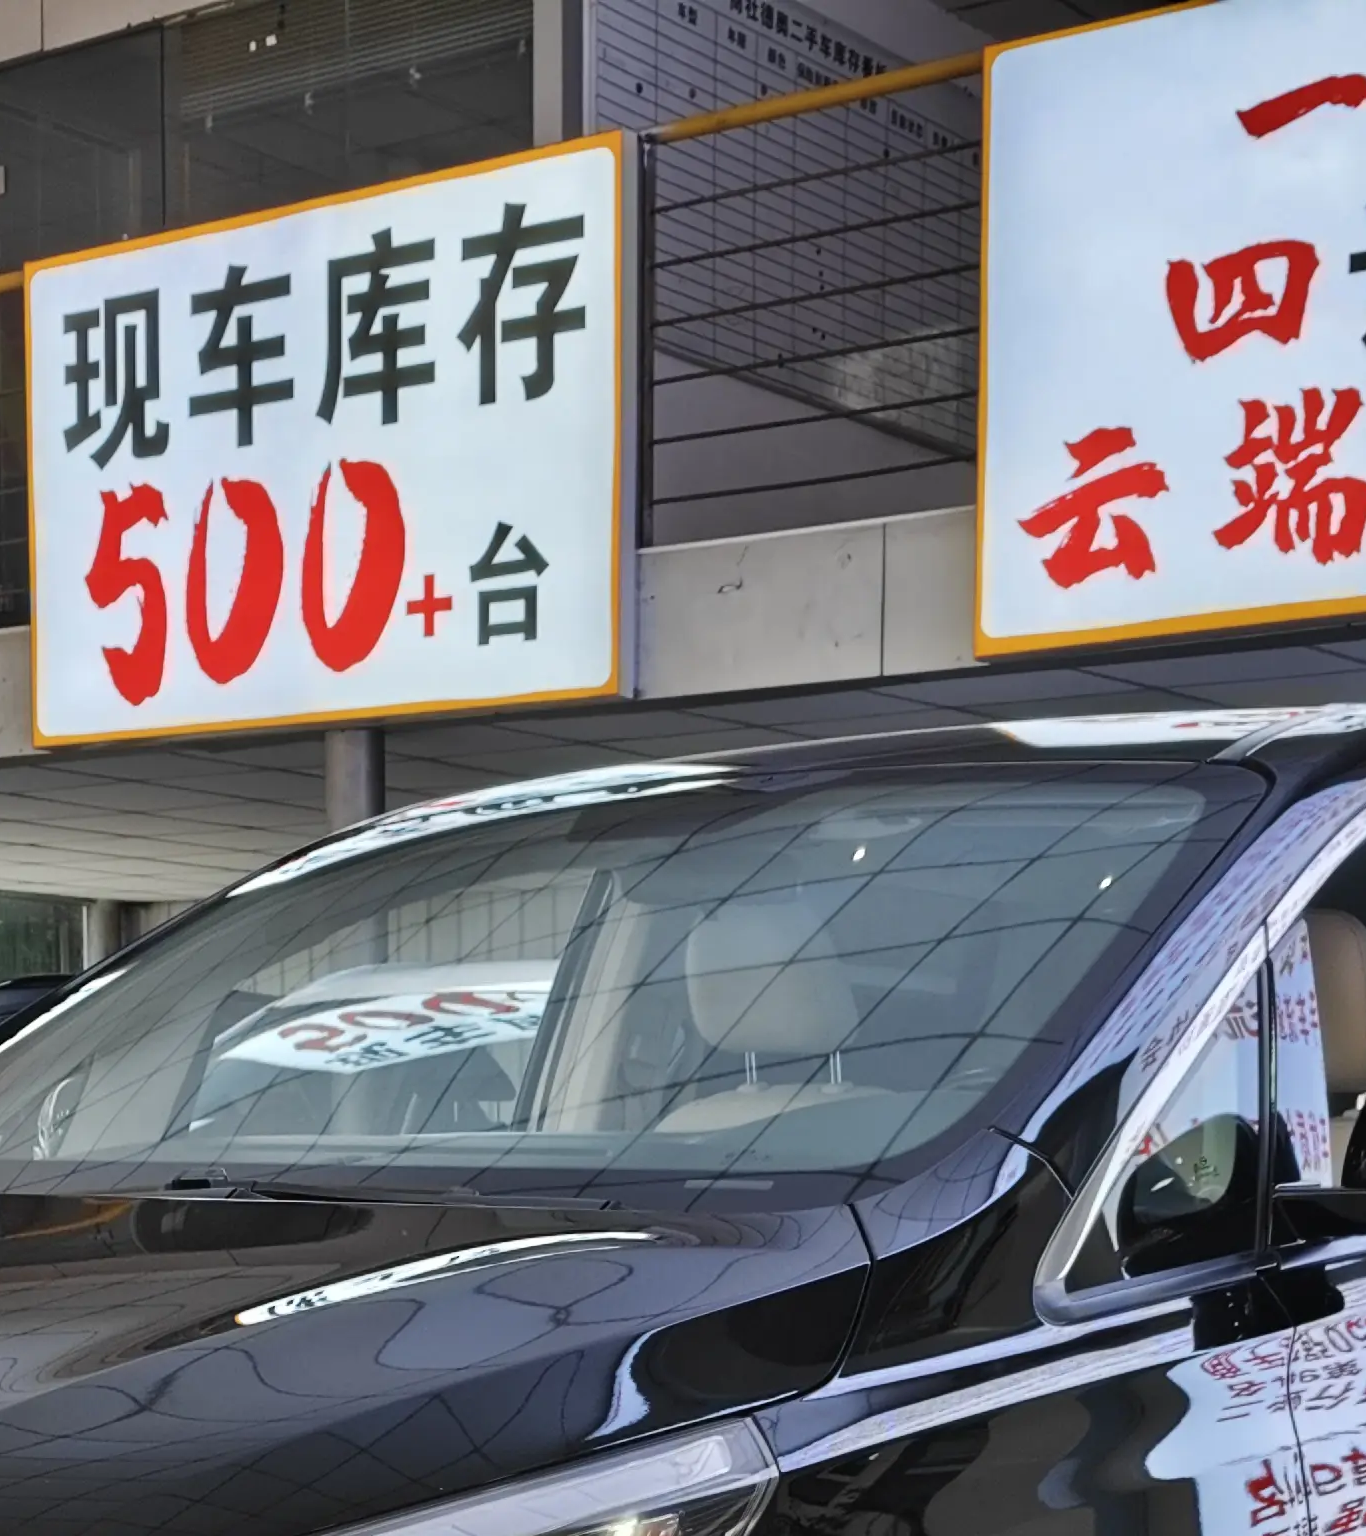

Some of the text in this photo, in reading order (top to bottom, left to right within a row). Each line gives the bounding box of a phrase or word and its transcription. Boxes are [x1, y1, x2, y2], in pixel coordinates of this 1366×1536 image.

[63, 203, 586, 470] 现车库存
[85, 458, 549, 706] 500+台
